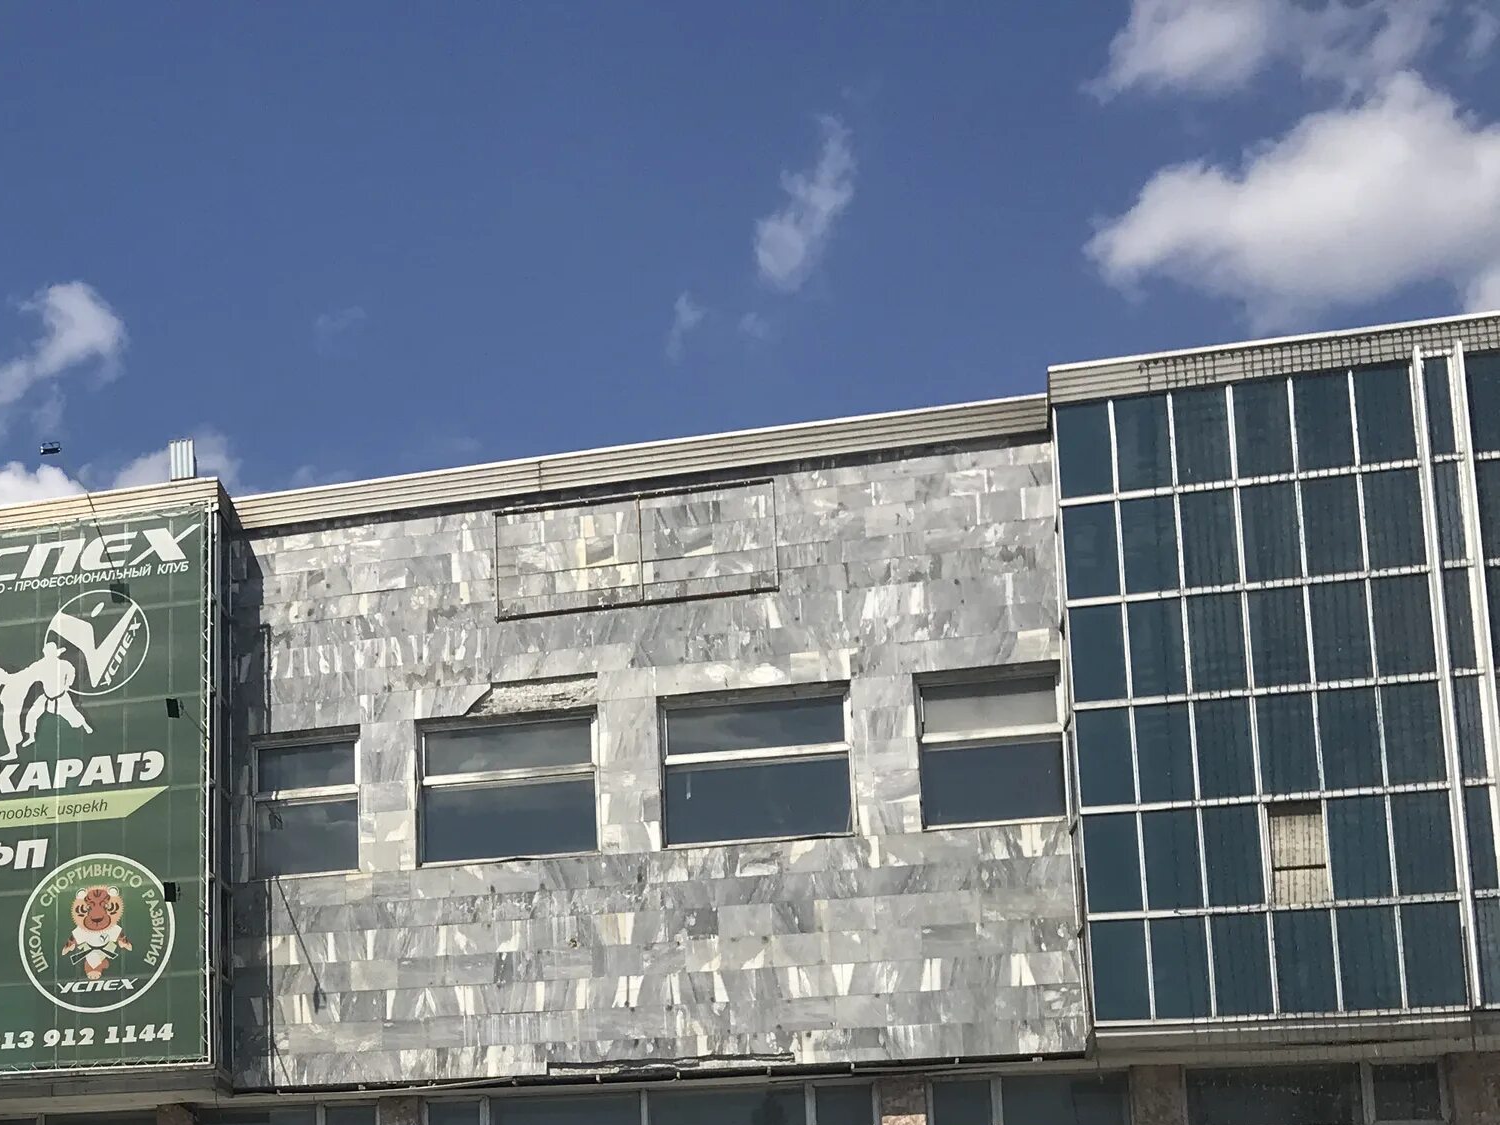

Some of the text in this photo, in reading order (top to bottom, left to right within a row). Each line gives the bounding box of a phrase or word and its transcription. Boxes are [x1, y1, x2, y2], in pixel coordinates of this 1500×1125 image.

[14, 564, 151, 592] ПРОФЕССИОНАЛЬНЫЙ
[157, 561, 190, 574] КЛУБ
[100, 618, 142, 687] УСПЕХ
[29, 863, 165, 973] ШКОЛА СПОРТИВНОГО РАЗВИТИЯ
[57, 978, 138, 994] УСПЕХ
[43, 1028, 94, 1047] 912
[104, 1023, 174, 1043] 1144
